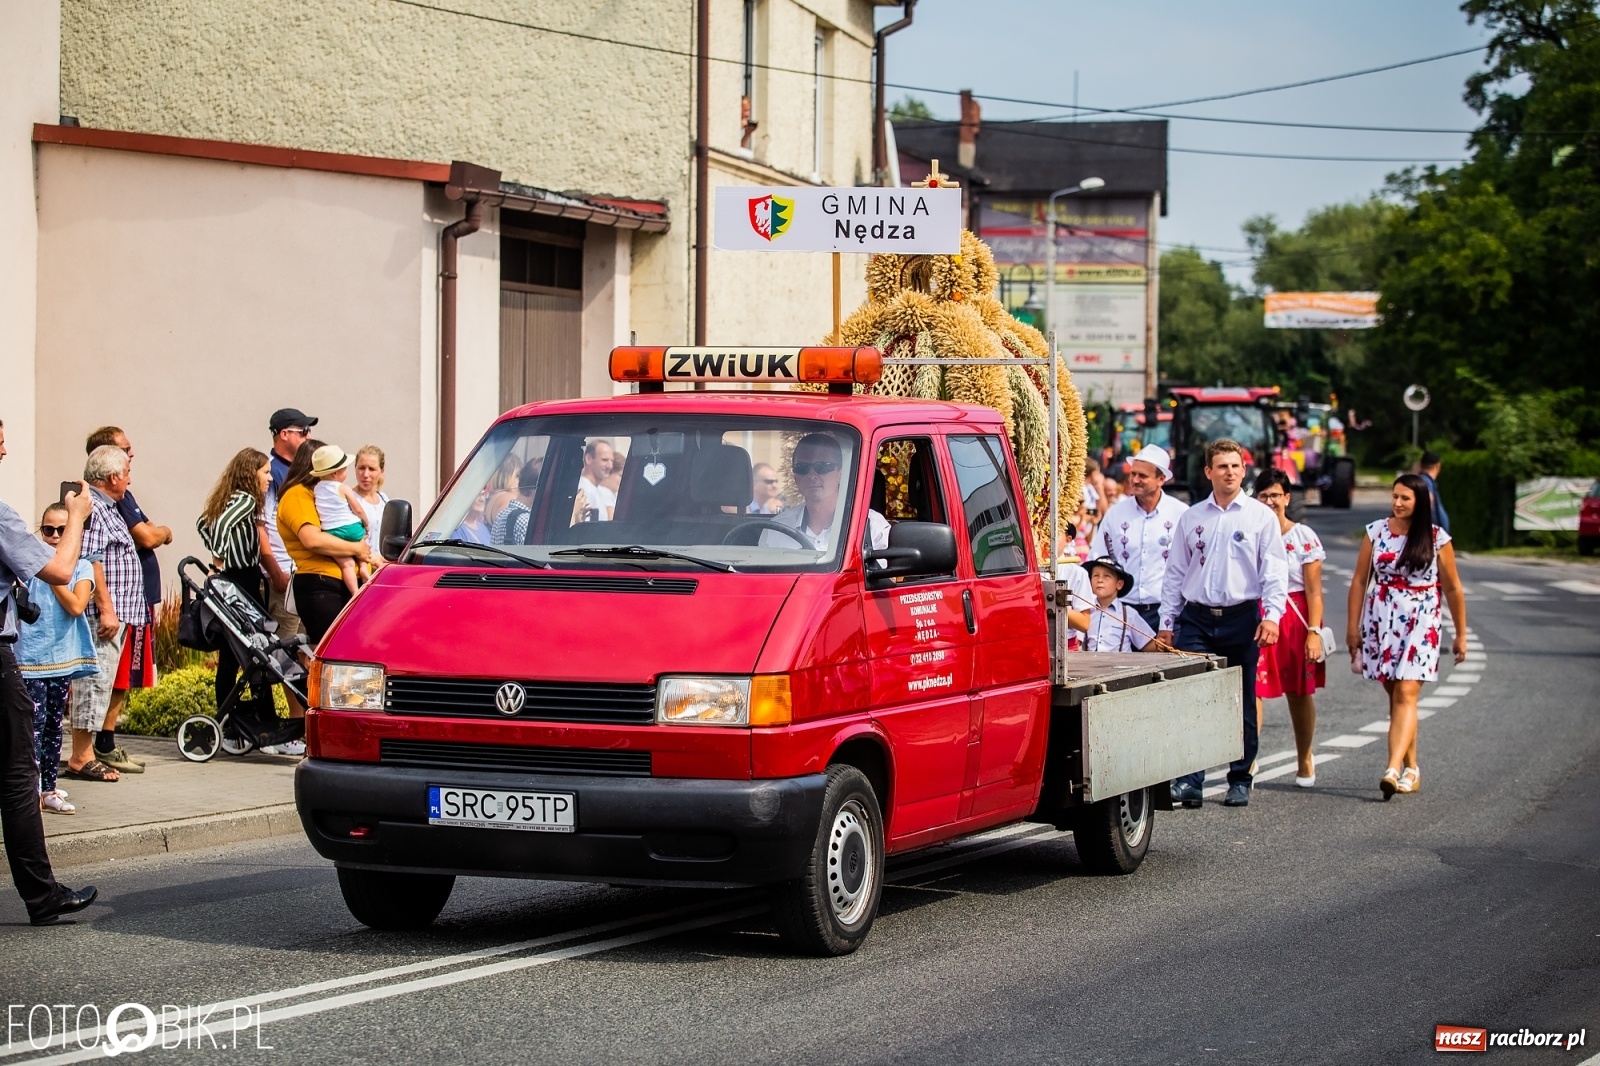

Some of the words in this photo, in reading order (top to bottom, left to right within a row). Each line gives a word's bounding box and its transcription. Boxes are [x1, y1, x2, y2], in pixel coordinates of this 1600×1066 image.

[821, 194, 930, 216] GMINA
[834, 219, 916, 244] Nędza
[667, 353, 794, 378] ZWiUK
[908, 672, 953, 691] www.pknedza.pl
[431, 806, 440, 814] PL
[444, 791, 497, 820] SRC
[506, 795, 569, 823] 95TP
